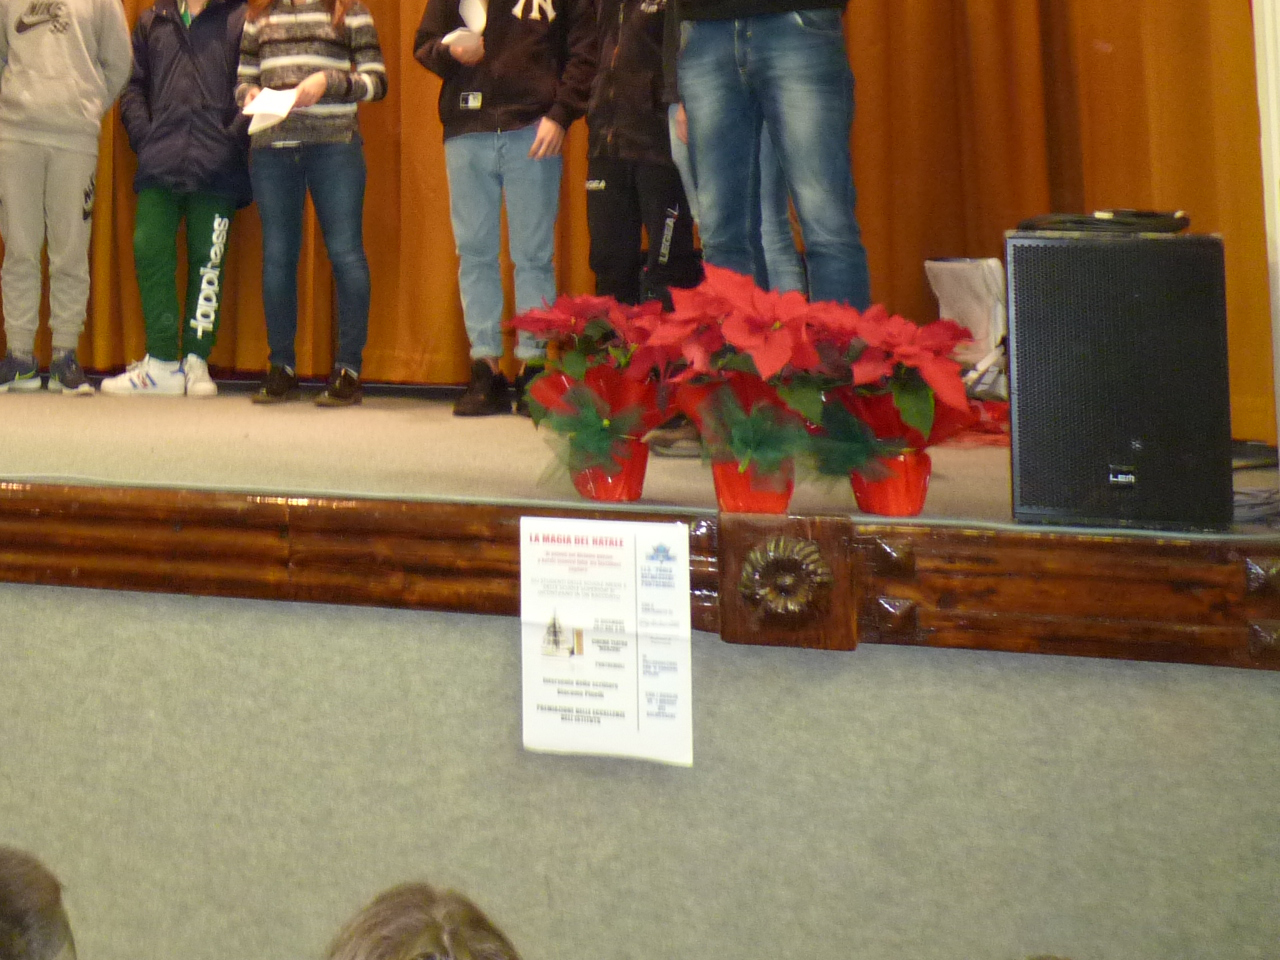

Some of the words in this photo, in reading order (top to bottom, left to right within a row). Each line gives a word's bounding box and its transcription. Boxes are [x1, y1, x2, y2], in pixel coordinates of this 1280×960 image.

[529, 532, 540, 543] LA
[542, 533, 572, 545] MAGIA
[574, 534, 589, 546] DEL
[592, 535, 624, 548] NATALE
